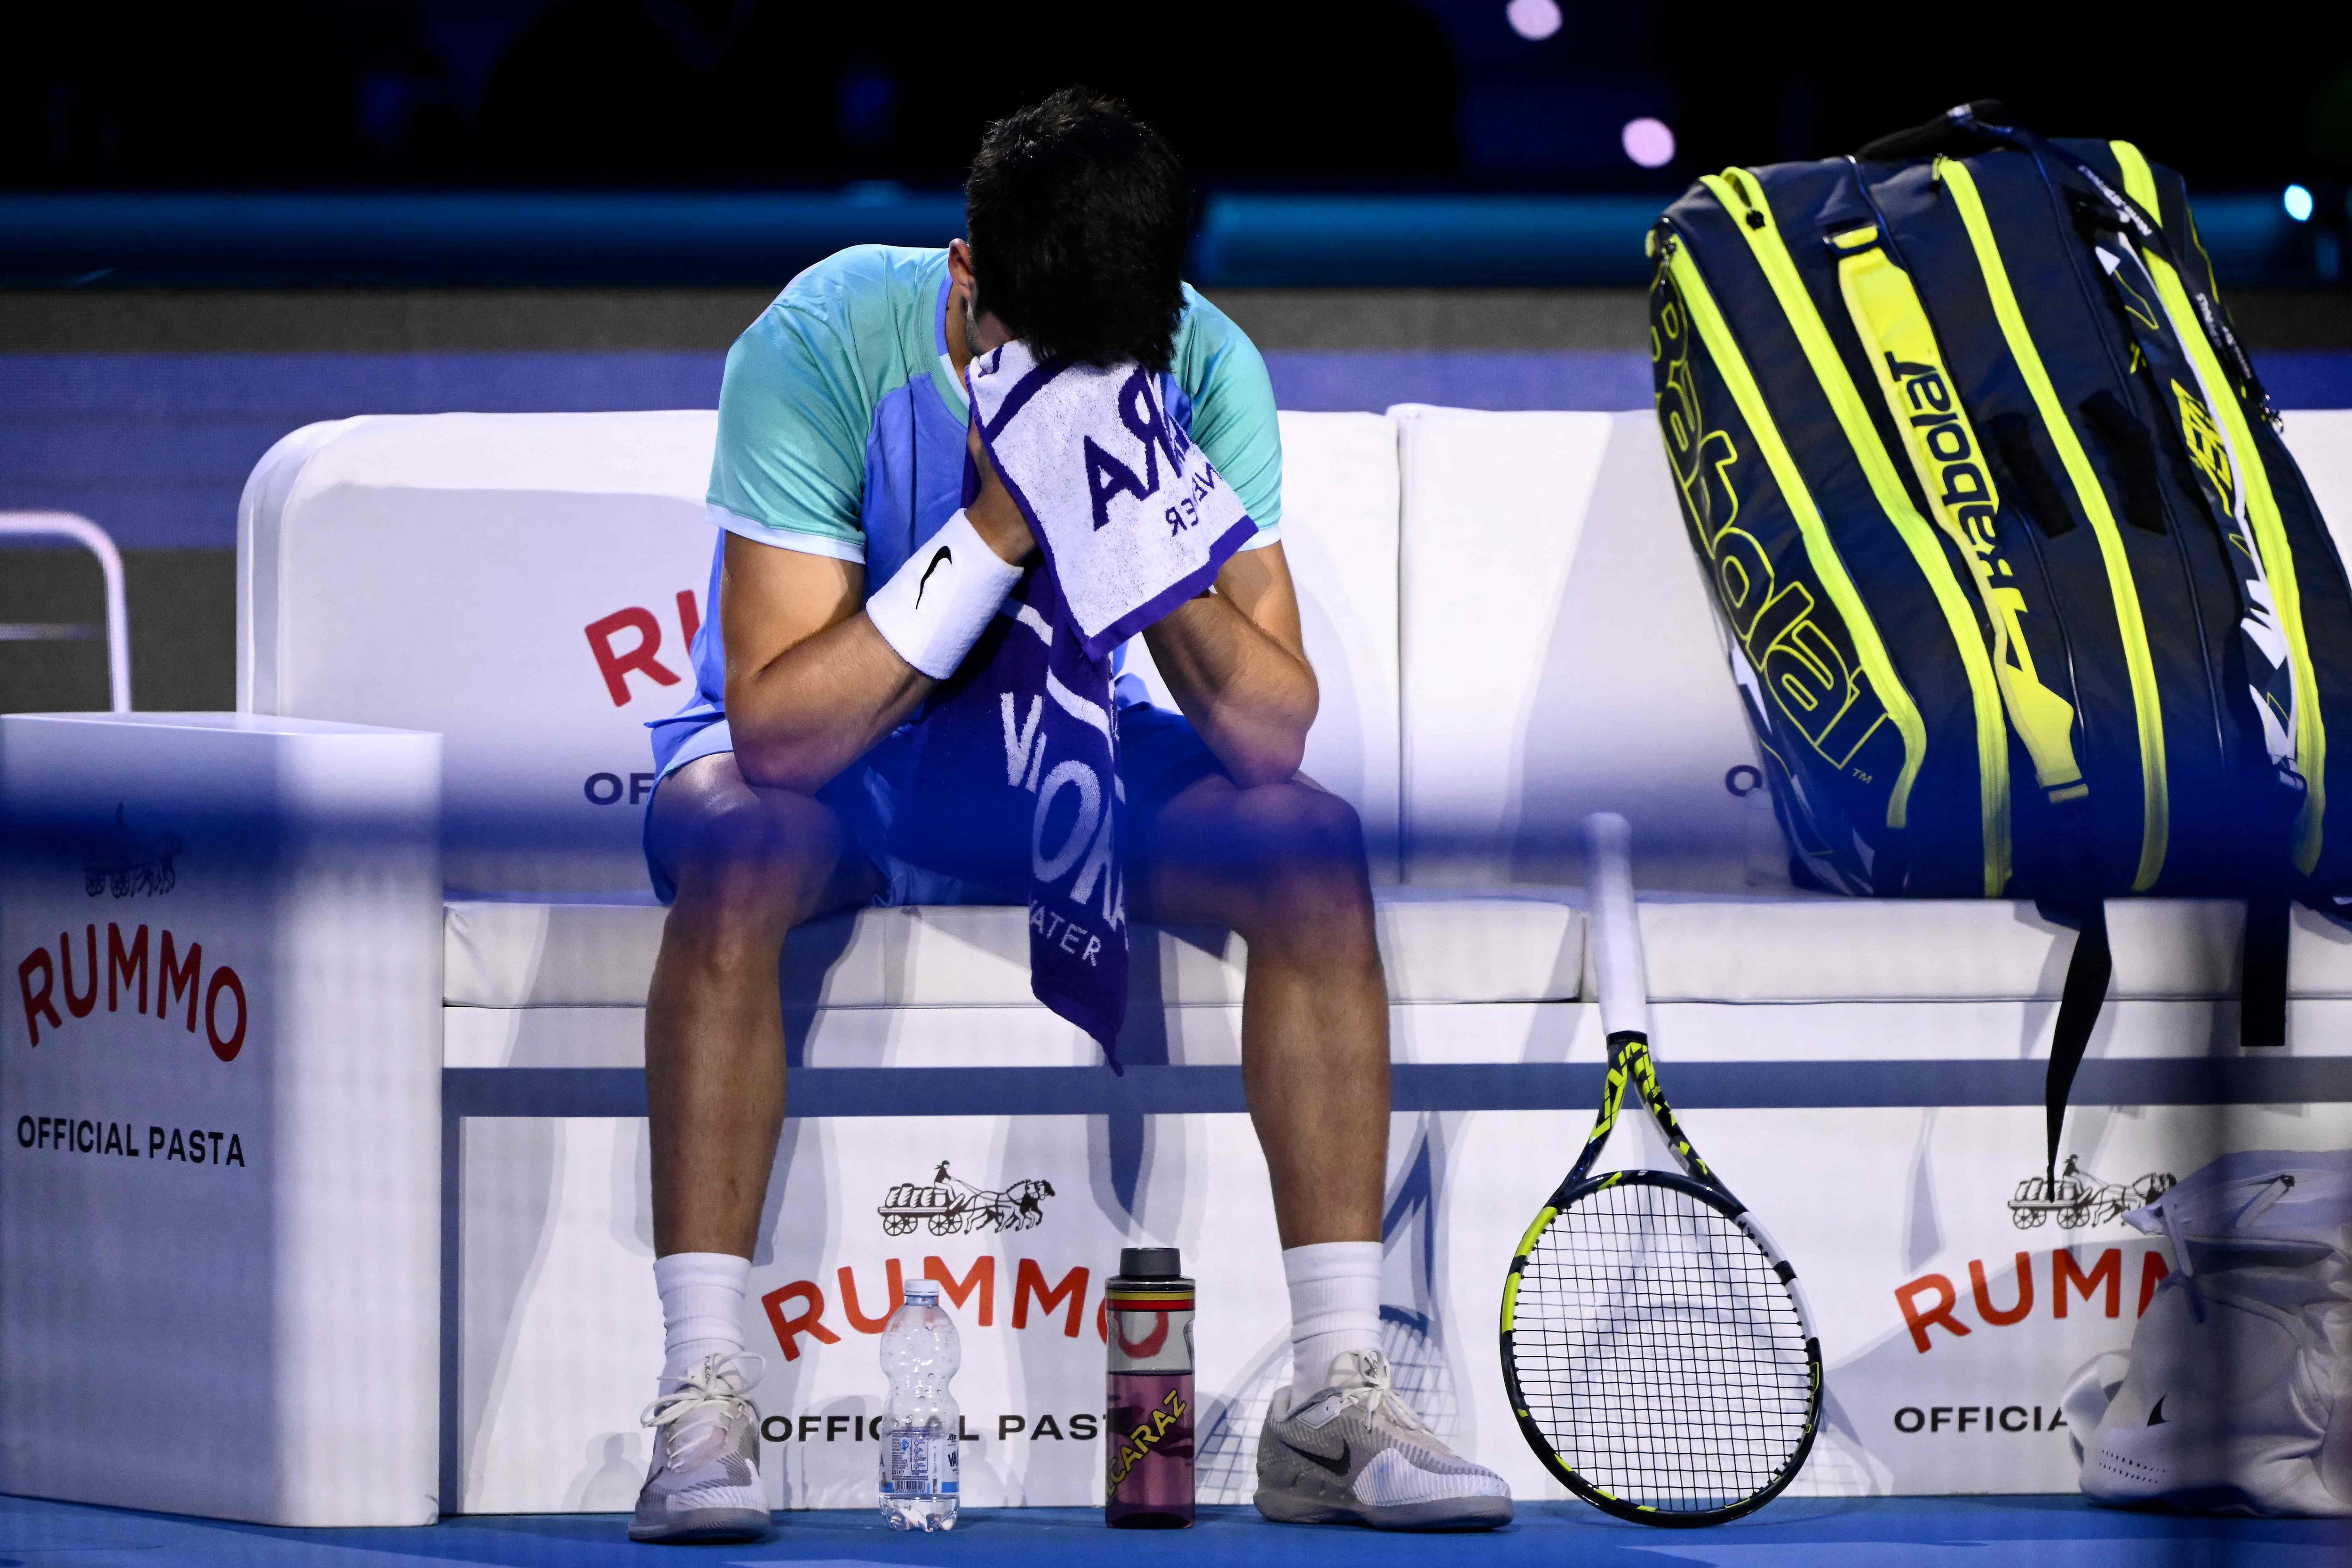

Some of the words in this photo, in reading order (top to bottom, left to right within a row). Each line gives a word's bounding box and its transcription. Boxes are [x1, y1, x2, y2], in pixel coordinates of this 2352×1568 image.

[1030, 899, 1102, 967] ATER
[18, 922, 247, 1062] RUMMO
[17, 1115, 140, 1157] OFFICIAL
[149, 1126, 246, 1168] PASTA
